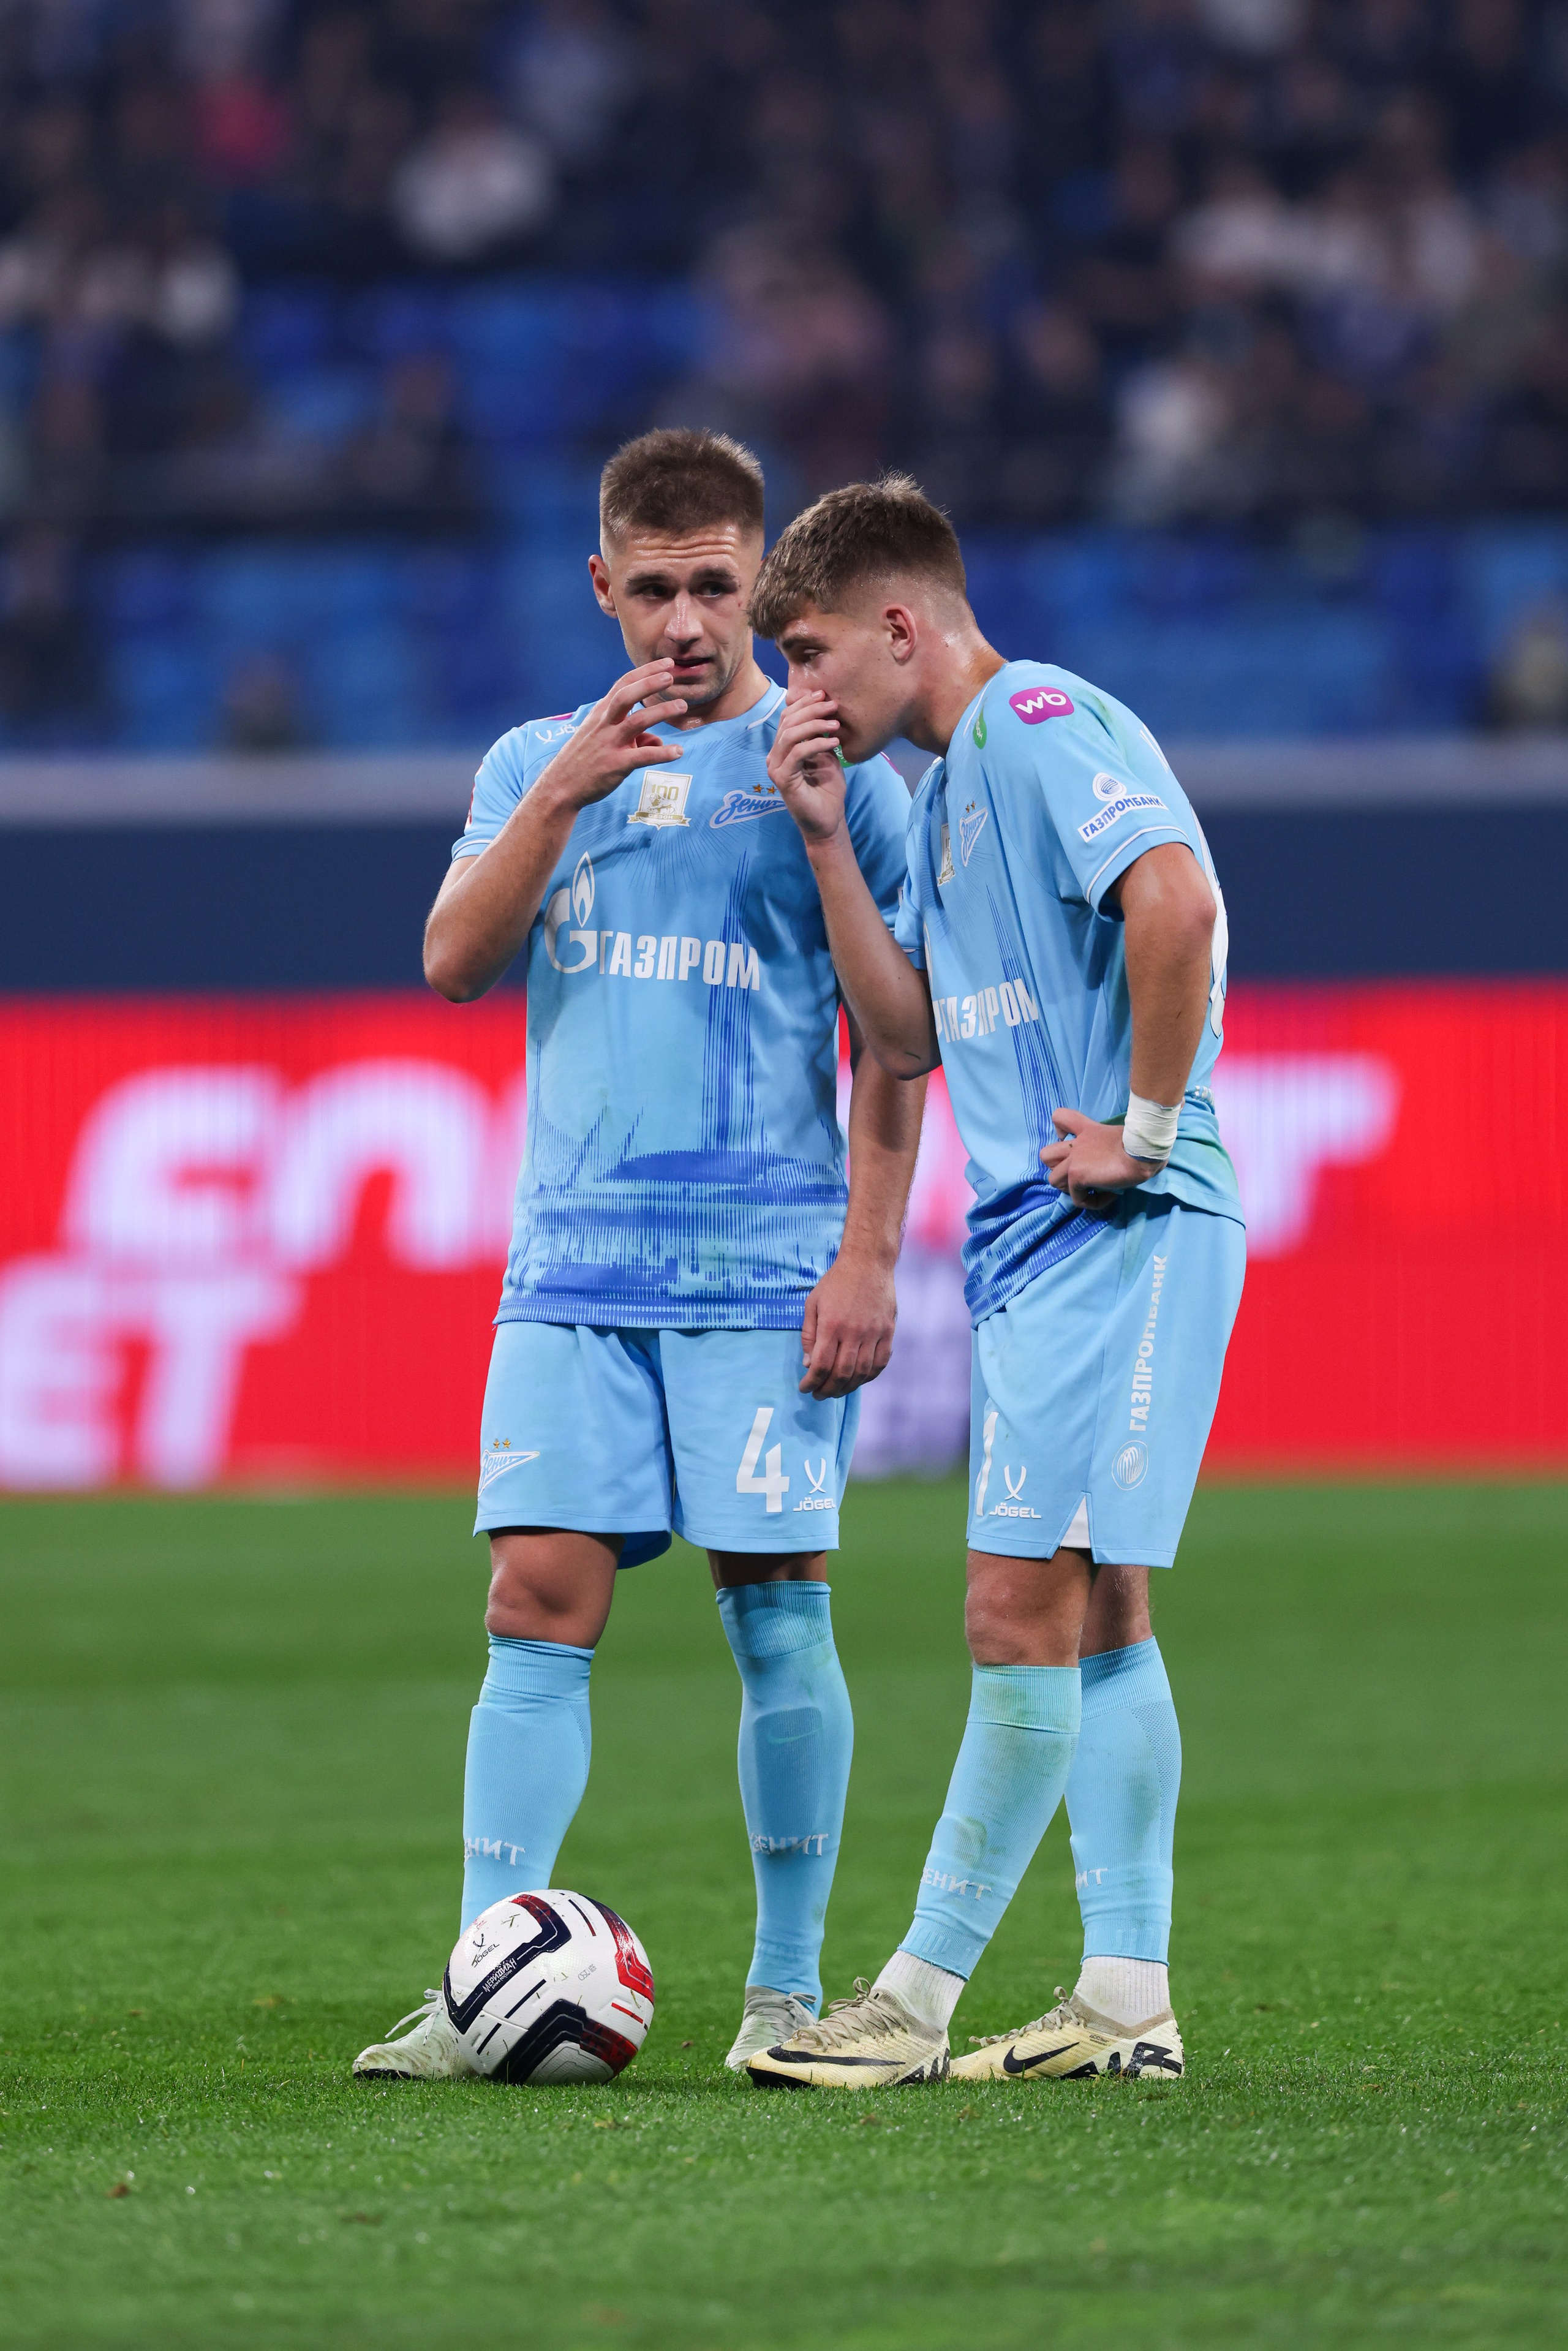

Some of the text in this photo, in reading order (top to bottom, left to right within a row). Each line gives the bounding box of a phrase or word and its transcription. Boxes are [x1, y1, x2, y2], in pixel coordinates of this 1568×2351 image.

[1015, 691, 1067, 715] wb
[1082, 796, 1164, 838] ГАЗПРОМБАНК
[599, 930, 761, 992] ГАЗПРОМ
[1129, 1255, 1167, 1432] ГАЗПРОМБАНК
[736, 1407, 790, 1514] 4
[989, 1502, 1042, 1519] JÖGEL
[921, 1867, 992, 1901] ЕНИТ
